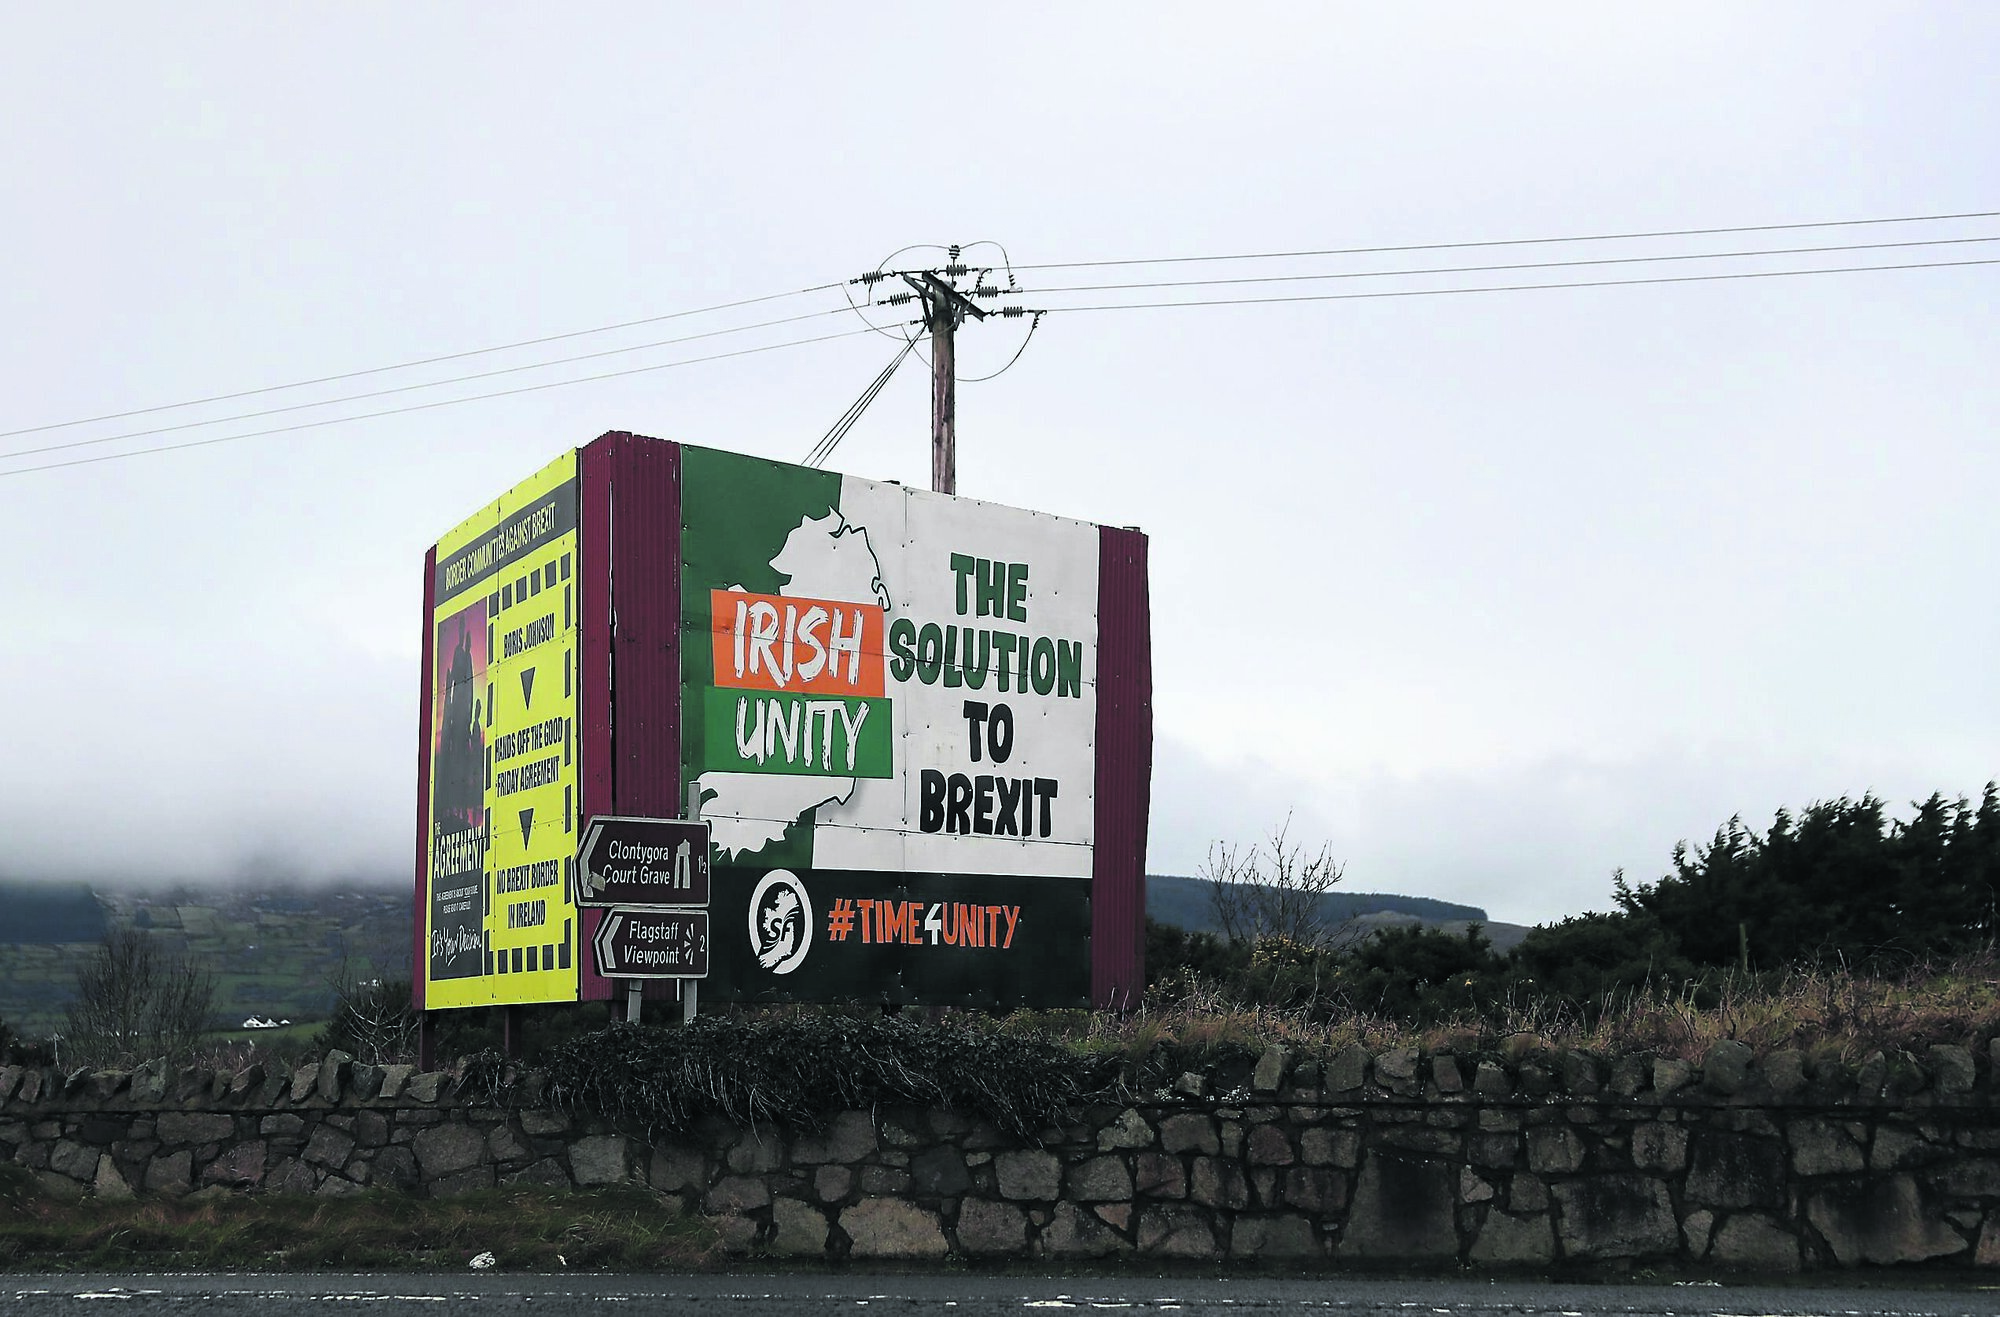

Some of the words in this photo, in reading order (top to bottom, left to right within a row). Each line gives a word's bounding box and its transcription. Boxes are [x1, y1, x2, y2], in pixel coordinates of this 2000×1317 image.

[445, 556, 467, 591] BORDER
[505, 515, 532, 555] AGAINST
[532, 501, 556, 539] BREXIT
[949, 552, 1029, 623] THE
[504, 627, 523, 659] BORIS
[524, 612, 555, 650] JOHNSON
[734, 599, 864, 688] IRISH
[888, 617, 1082, 699] SOLUTION
[495, 732, 516, 764] HANDS
[517, 728, 530, 756] OFF
[531, 723, 543, 751] THE
[544, 716, 563, 747] GOOD
[734, 695, 870, 772] UNITY
[962, 700, 1016, 765] TO
[497, 768, 519, 798] FRIDAY
[520, 755, 560, 791] AGREEMENT
[918, 768, 1059, 838] BREXIT
[433, 825, 483, 880] AGREEMENT
[602, 864, 637, 885] Court
[640, 865, 671, 885] Grave
[608, 840, 669, 865] Clontygora
[496, 869, 506, 895] NO
[506, 864, 531, 893] BREXIT
[531, 859, 559, 889] BORDER
[508, 903, 515, 929] IN
[516, 899, 546, 929] IRELAND
[629, 920, 680, 943] Flagstaff
[827, 897, 1021, 949] #TIME4UNITY
[623, 944, 680, 968] Viewpoint
[699, 934, 706, 952] 2
